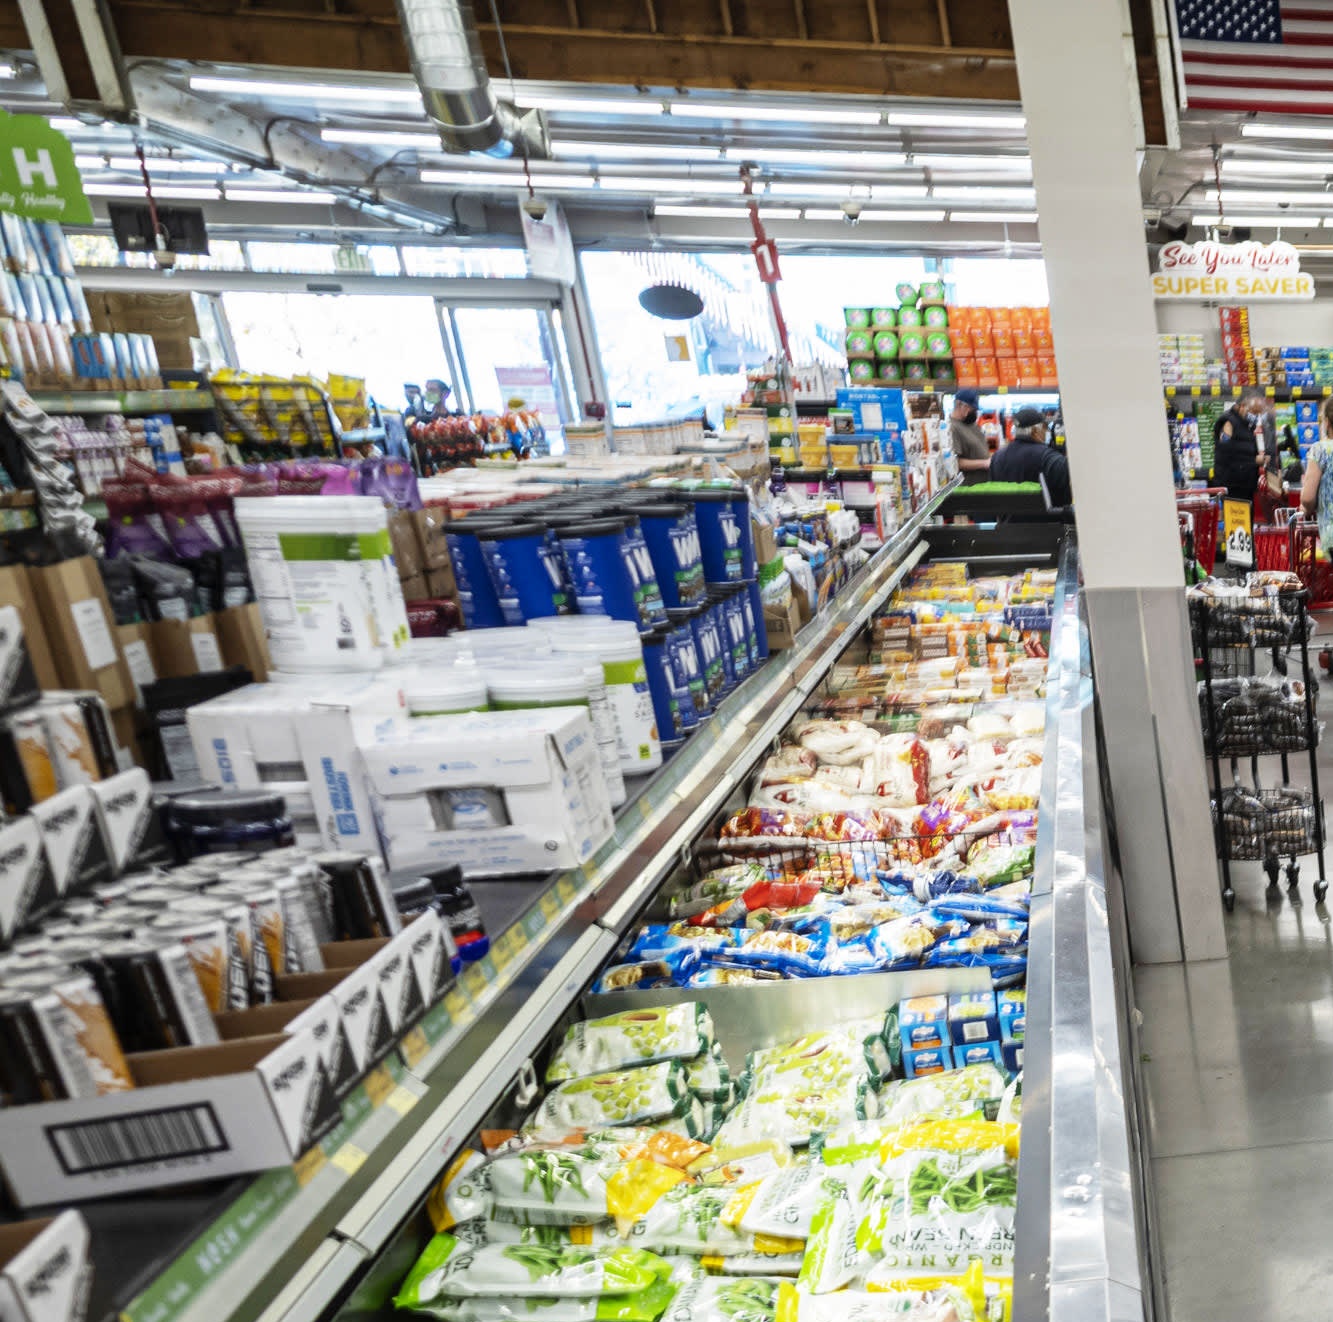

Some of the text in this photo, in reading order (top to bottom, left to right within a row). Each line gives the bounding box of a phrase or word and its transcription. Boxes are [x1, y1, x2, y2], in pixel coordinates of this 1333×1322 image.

[11, 147, 58, 188] H
[756, 244, 774, 274] 1
[1164, 245, 1295, 274] See You Later
[1153, 277, 1309, 294] SUPER SAVER
